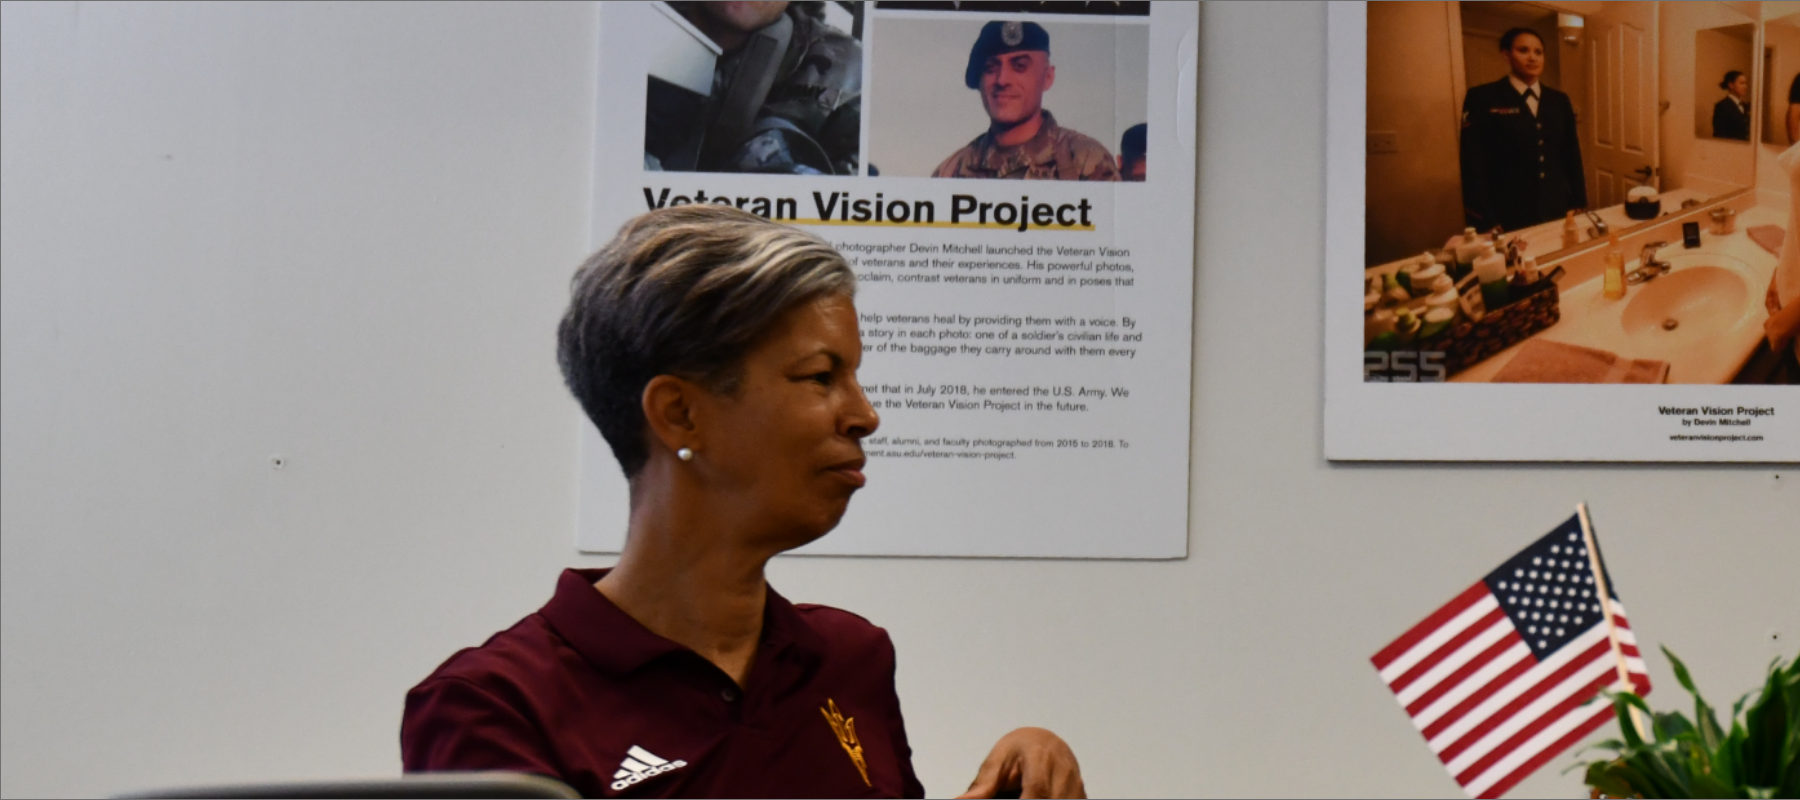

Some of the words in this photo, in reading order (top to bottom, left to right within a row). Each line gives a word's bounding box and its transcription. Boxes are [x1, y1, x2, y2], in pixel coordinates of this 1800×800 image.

[813, 191, 934, 223] Vision
[951, 195, 1093, 232] Project
[835, 242, 906, 255] photographer
[909, 243, 939, 253] Devin
[943, 244, 982, 254] Mitchell
[986, 245, 1033, 255] launched
[1037, 246, 1053, 256] the
[1057, 246, 1095, 256] Veteran
[1099, 247, 1130, 257] Vision
[862, 258, 905, 267] veterans
[909, 258, 928, 268] and
[932, 259, 954, 268] their
[958, 260, 1023, 270] experiences.
[1027, 260, 1044, 270] His
[1048, 261, 1092, 273] powerful
[1096, 261, 1133, 273] photos,
[897, 274, 940, 282] contrast
[944, 275, 987, 284] veterans
[1003, 274, 1041, 284] uniform
[1044, 276, 1064, 285] and
[1068, 276, 1077, 285] in
[1080, 278, 1112, 287] poses
[1115, 277, 1134, 286] that
[861, 313, 883, 324] help
[886, 315, 930, 323] veterans
[934, 314, 955, 324] heal
[959, 315, 971, 327] by
[974, 316, 1022, 328] providing
[1026, 316, 1051, 325] them
[1055, 317, 1076, 326] with
[1089, 318, 1118, 327] voice.
[1123, 317, 1136, 329] By
[868, 329, 894, 340] story
[910, 329, 936, 338] each
[939, 328, 971, 340] photo:
[998, 330, 1008, 339] of
[1012, 332, 1018, 340] a
[1021, 331, 1064, 340] soldier's
[1067, 332, 1101, 341] civilian
[1105, 332, 1119, 341] life
[1123, 332, 1142, 342] and
[876, 343, 887, 352] of
[890, 344, 906, 352] the
[910, 344, 957, 356] baggage
[960, 344, 982, 356] they
[985, 347, 1011, 357] carry
[1015, 346, 1051, 355] around
[1055, 346, 1076, 355] with
[1080, 346, 1105, 355] them
[1108, 349, 1136, 359] every
[1364, 350, 1446, 382] 255
[882, 384, 901, 393] that
[917, 385, 936, 397] July
[940, 385, 969, 397] 2018,
[973, 385, 986, 395] he
[990, 386, 1029, 396] entered
[1033, 387, 1049, 396] the
[1053, 386, 1074, 397] U.S.
[1079, 387, 1108, 399] Army.
[1111, 387, 1129, 397] We
[885, 399, 901, 408] the
[906, 399, 945, 409] Veteran
[948, 400, 980, 410] Vision
[983, 400, 1020, 413] Project
[1024, 401, 1033, 410] in
[1037, 401, 1053, 411] the
[1057, 401, 1088, 411] future.
[1658, 406, 1698, 416] Veteran
[1701, 406, 1734, 416] Vision
[1737, 406, 1775, 418] Project
[1682, 418, 1692, 427] by
[1719, 418, 1751, 426] Mitchell
[868, 437, 889, 445] staff,
[892, 437, 922, 447] alumni,
[924, 438, 940, 446] and
[943, 438, 970, 447] faculty
[973, 439, 1033, 448] photographed
[1035, 439, 1053, 447] from
[1057, 439, 1078, 448] 2015
[1092, 440, 1115, 448] 2018.
[1119, 440, 1129, 448] To
[1669, 434, 1764, 442] veteranvisionproject.com
[609, 758, 688, 789] adidas
